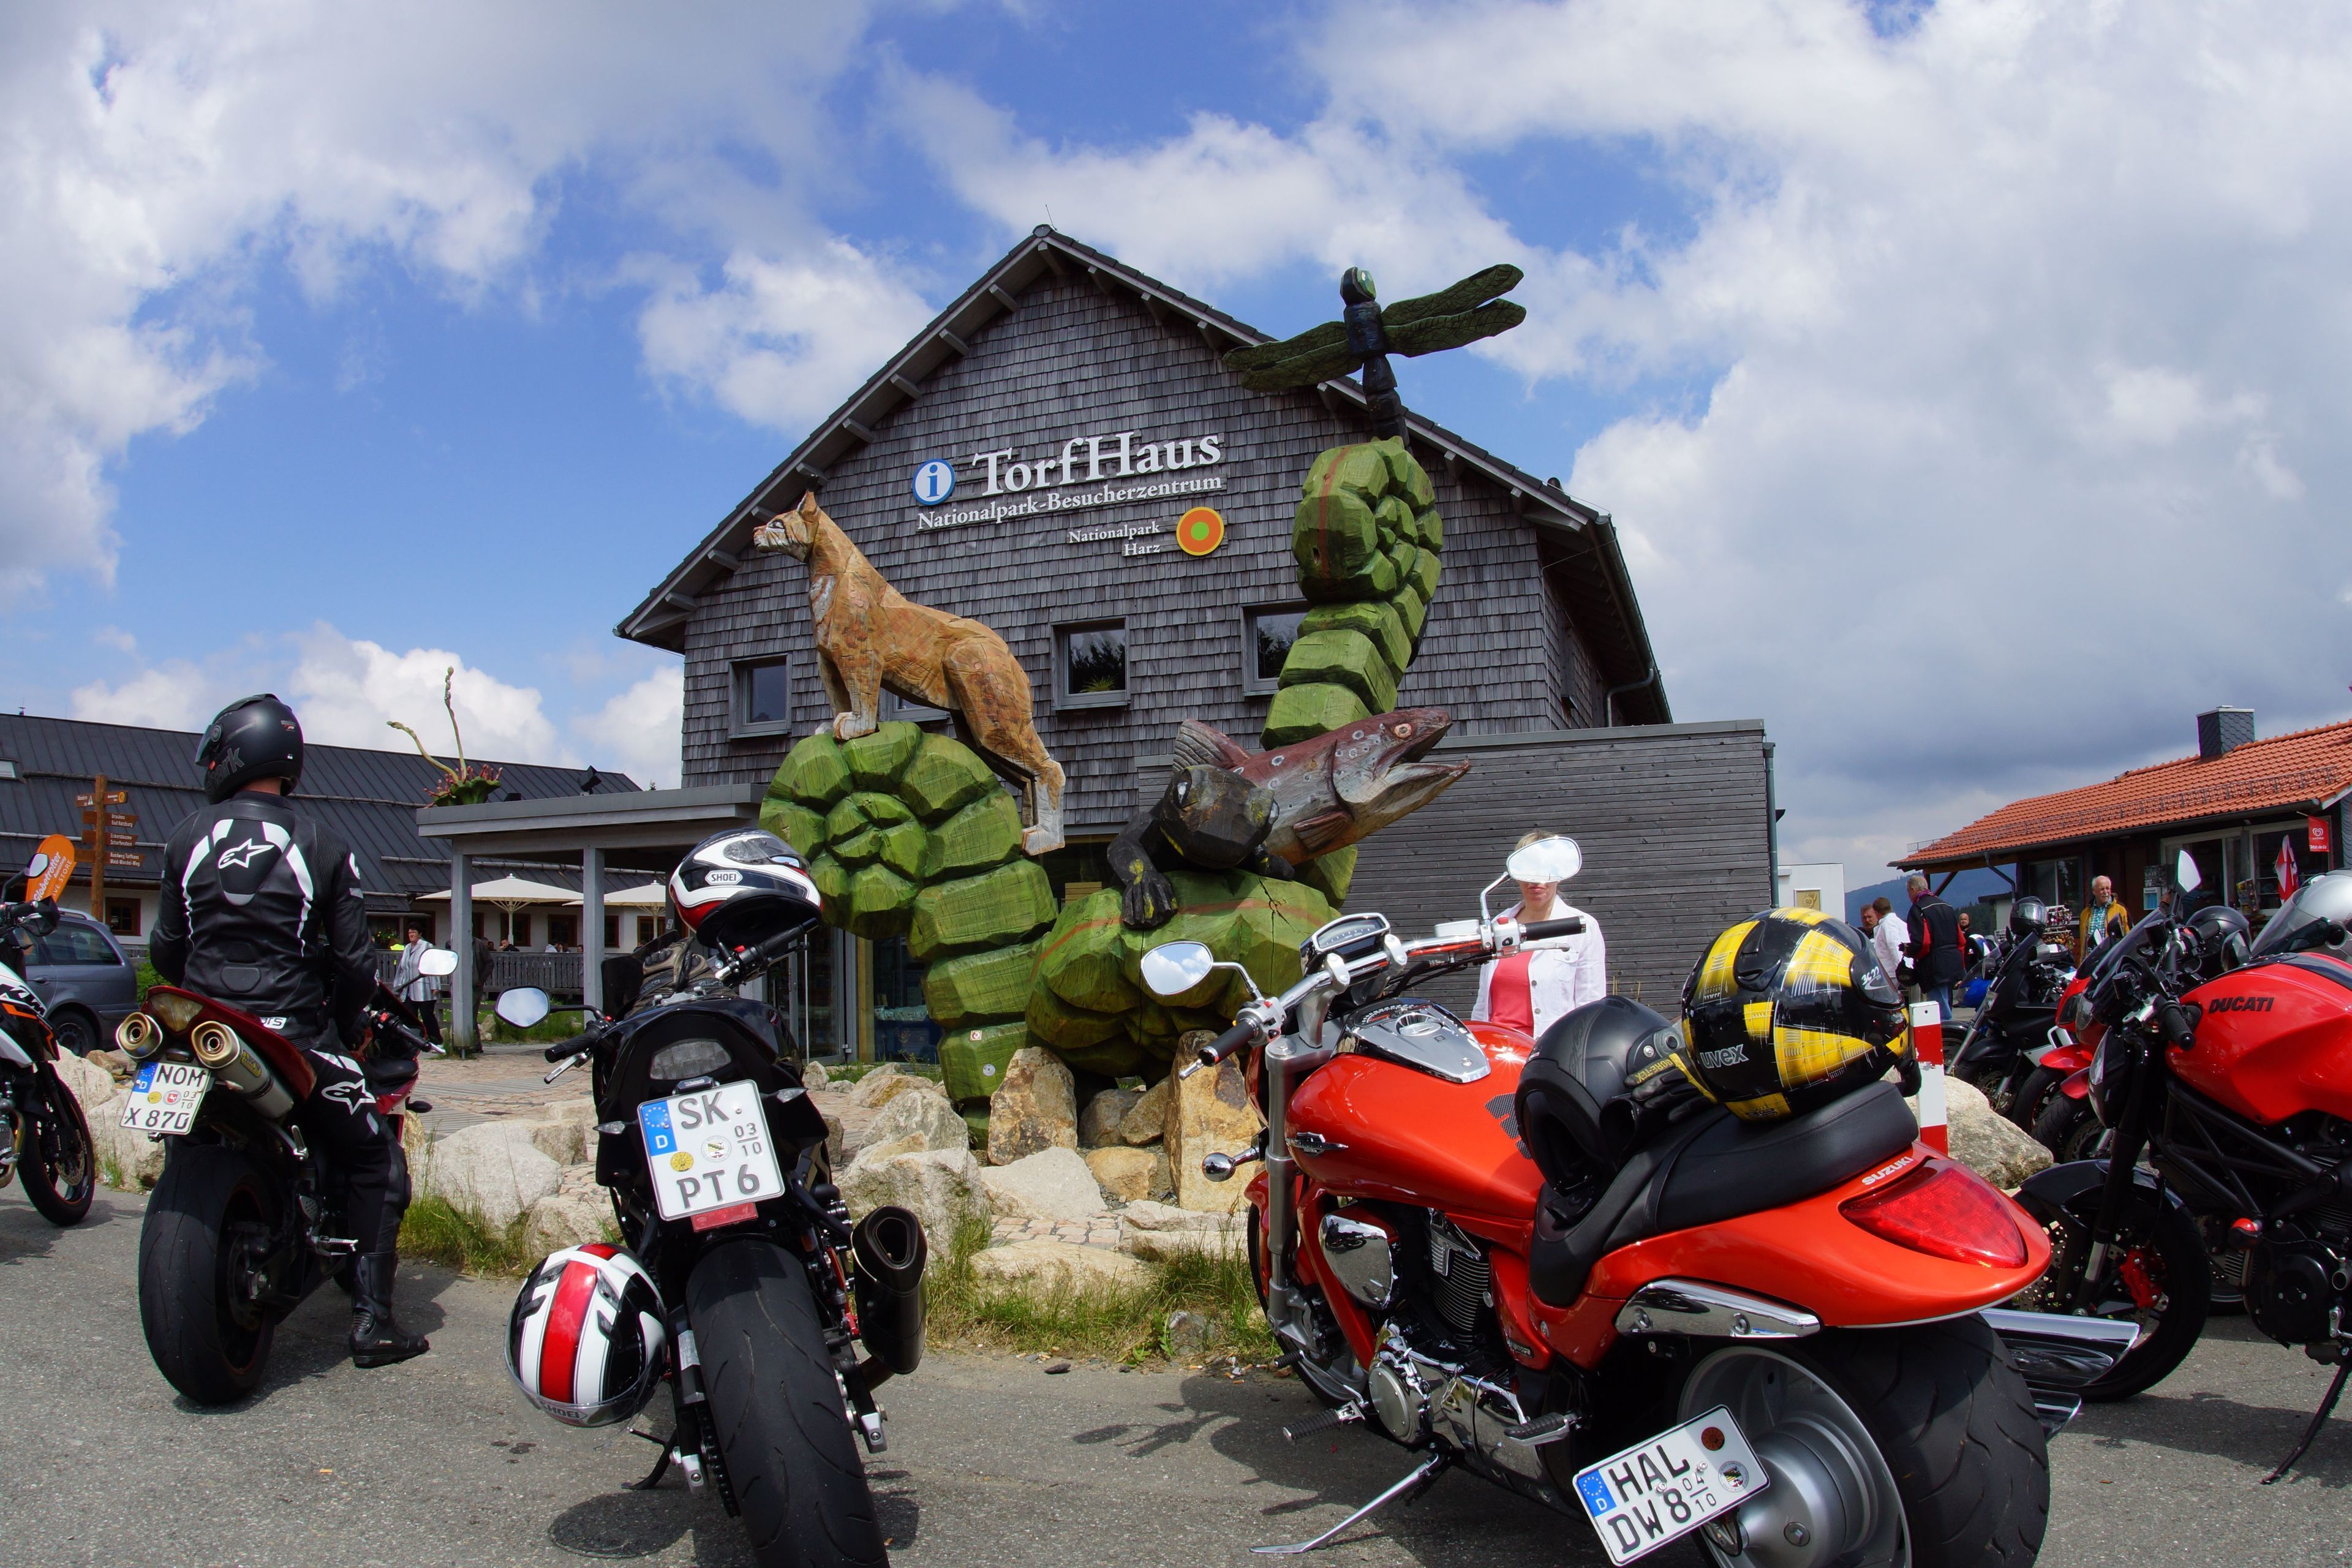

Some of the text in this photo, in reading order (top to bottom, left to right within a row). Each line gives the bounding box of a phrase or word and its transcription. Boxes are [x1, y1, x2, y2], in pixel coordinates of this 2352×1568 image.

[972, 432, 1221, 497] TorfHaus
[918, 476, 1223, 530] Nationalpark-Besucherzentrum
[1069, 521, 1161, 543] Nationalpark
[1124, 543, 1161, 557] Harz
[33, 851, 61, 902] Globetrotter
[59, 859, 73, 883] STORE
[711, 873, 737, 882] SHOEI
[2208, 997, 2275, 1014] DUCATI
[1700, 1044, 1749, 1069] uvex
[156, 1065, 205, 1087] NOM
[124, 1107, 190, 1130] X 870
[678, 1091, 729, 1129] SK
[655, 1135, 668, 1148] D
[735, 1123, 757, 1138] 03
[742, 1142, 763, 1158] 10
[1862, 1156, 1914, 1185] SUZUKI
[1608, 1444, 1691, 1502] HAL
[1682, 1471, 1705, 1491] 04
[1595, 1498, 1608, 1511] D
[1694, 1493, 1717, 1512] 10
